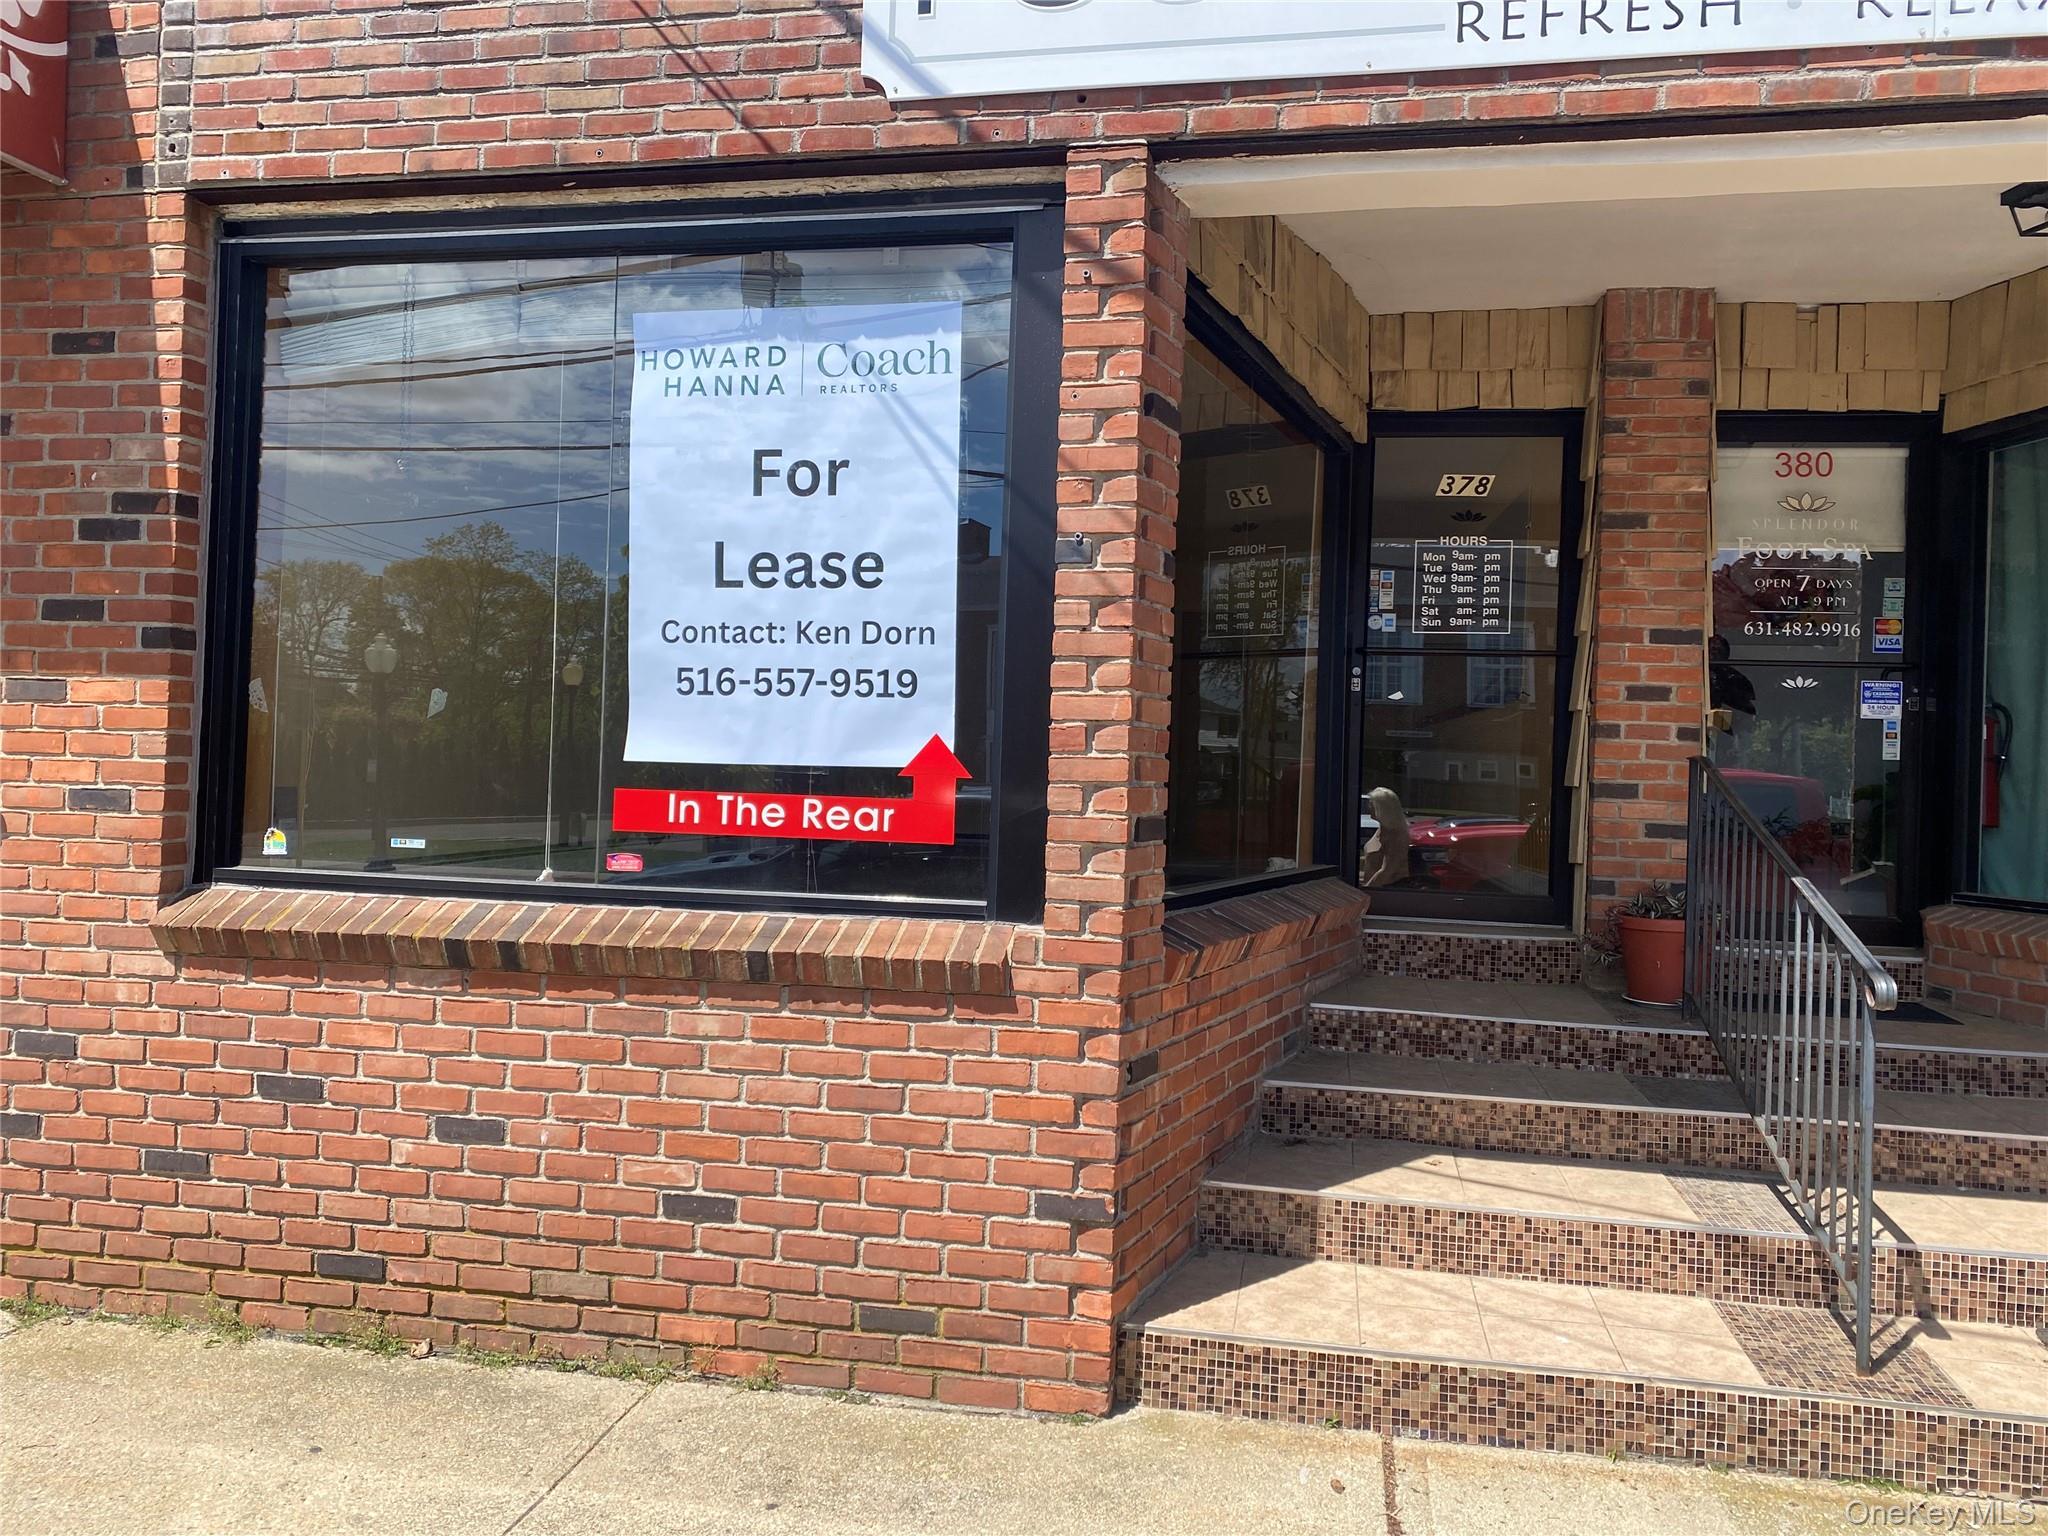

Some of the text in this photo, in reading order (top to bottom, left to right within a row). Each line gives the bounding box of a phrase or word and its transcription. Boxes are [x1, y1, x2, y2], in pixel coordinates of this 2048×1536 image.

[1457, 0, 1742, 43] REFRESH
[640, 345, 787, 372] HOWARD
[816, 339, 952, 378] Coach
[664, 374, 785, 397] HANNA
[820, 382, 898, 394] REALTORS
[752, 448, 850, 497] For
[1775, 452, 1834, 478] 380
[1440, 476, 1490, 495] 378
[1752, 518, 1859, 531] SPLENDOR
[1440, 536, 1488, 546] HOURS
[1423, 550, 1501, 562] Mon 9am- pm
[714, 541, 884, 589] Lease
[1423, 562, 1501, 573] Tue 9am- pm
[1422, 573, 1500, 584] Wed 9am- pm
[1754, 575, 1853, 592] OPEN 7 DAYS
[1422, 584, 1500, 595] Thu 9am- pm
[1421, 595, 1436, 605] Fri
[1483, 597, 1499, 606] pm
[1813, 597, 1821, 606] 9
[1826, 597, 1846, 607] PM
[1421, 607, 1439, 616] Sat
[1482, 608, 1499, 617] pm
[1421, 617, 1499, 628] Sun 9am- pm
[1744, 621, 1861, 637] 631.482.9916
[661, 619, 936, 646] Contact: Ken Dorn
[1878, 638, 1901, 646] VISA
[676, 667, 919, 698] 516-557-9519
[667, 792, 895, 833] In The Rear
